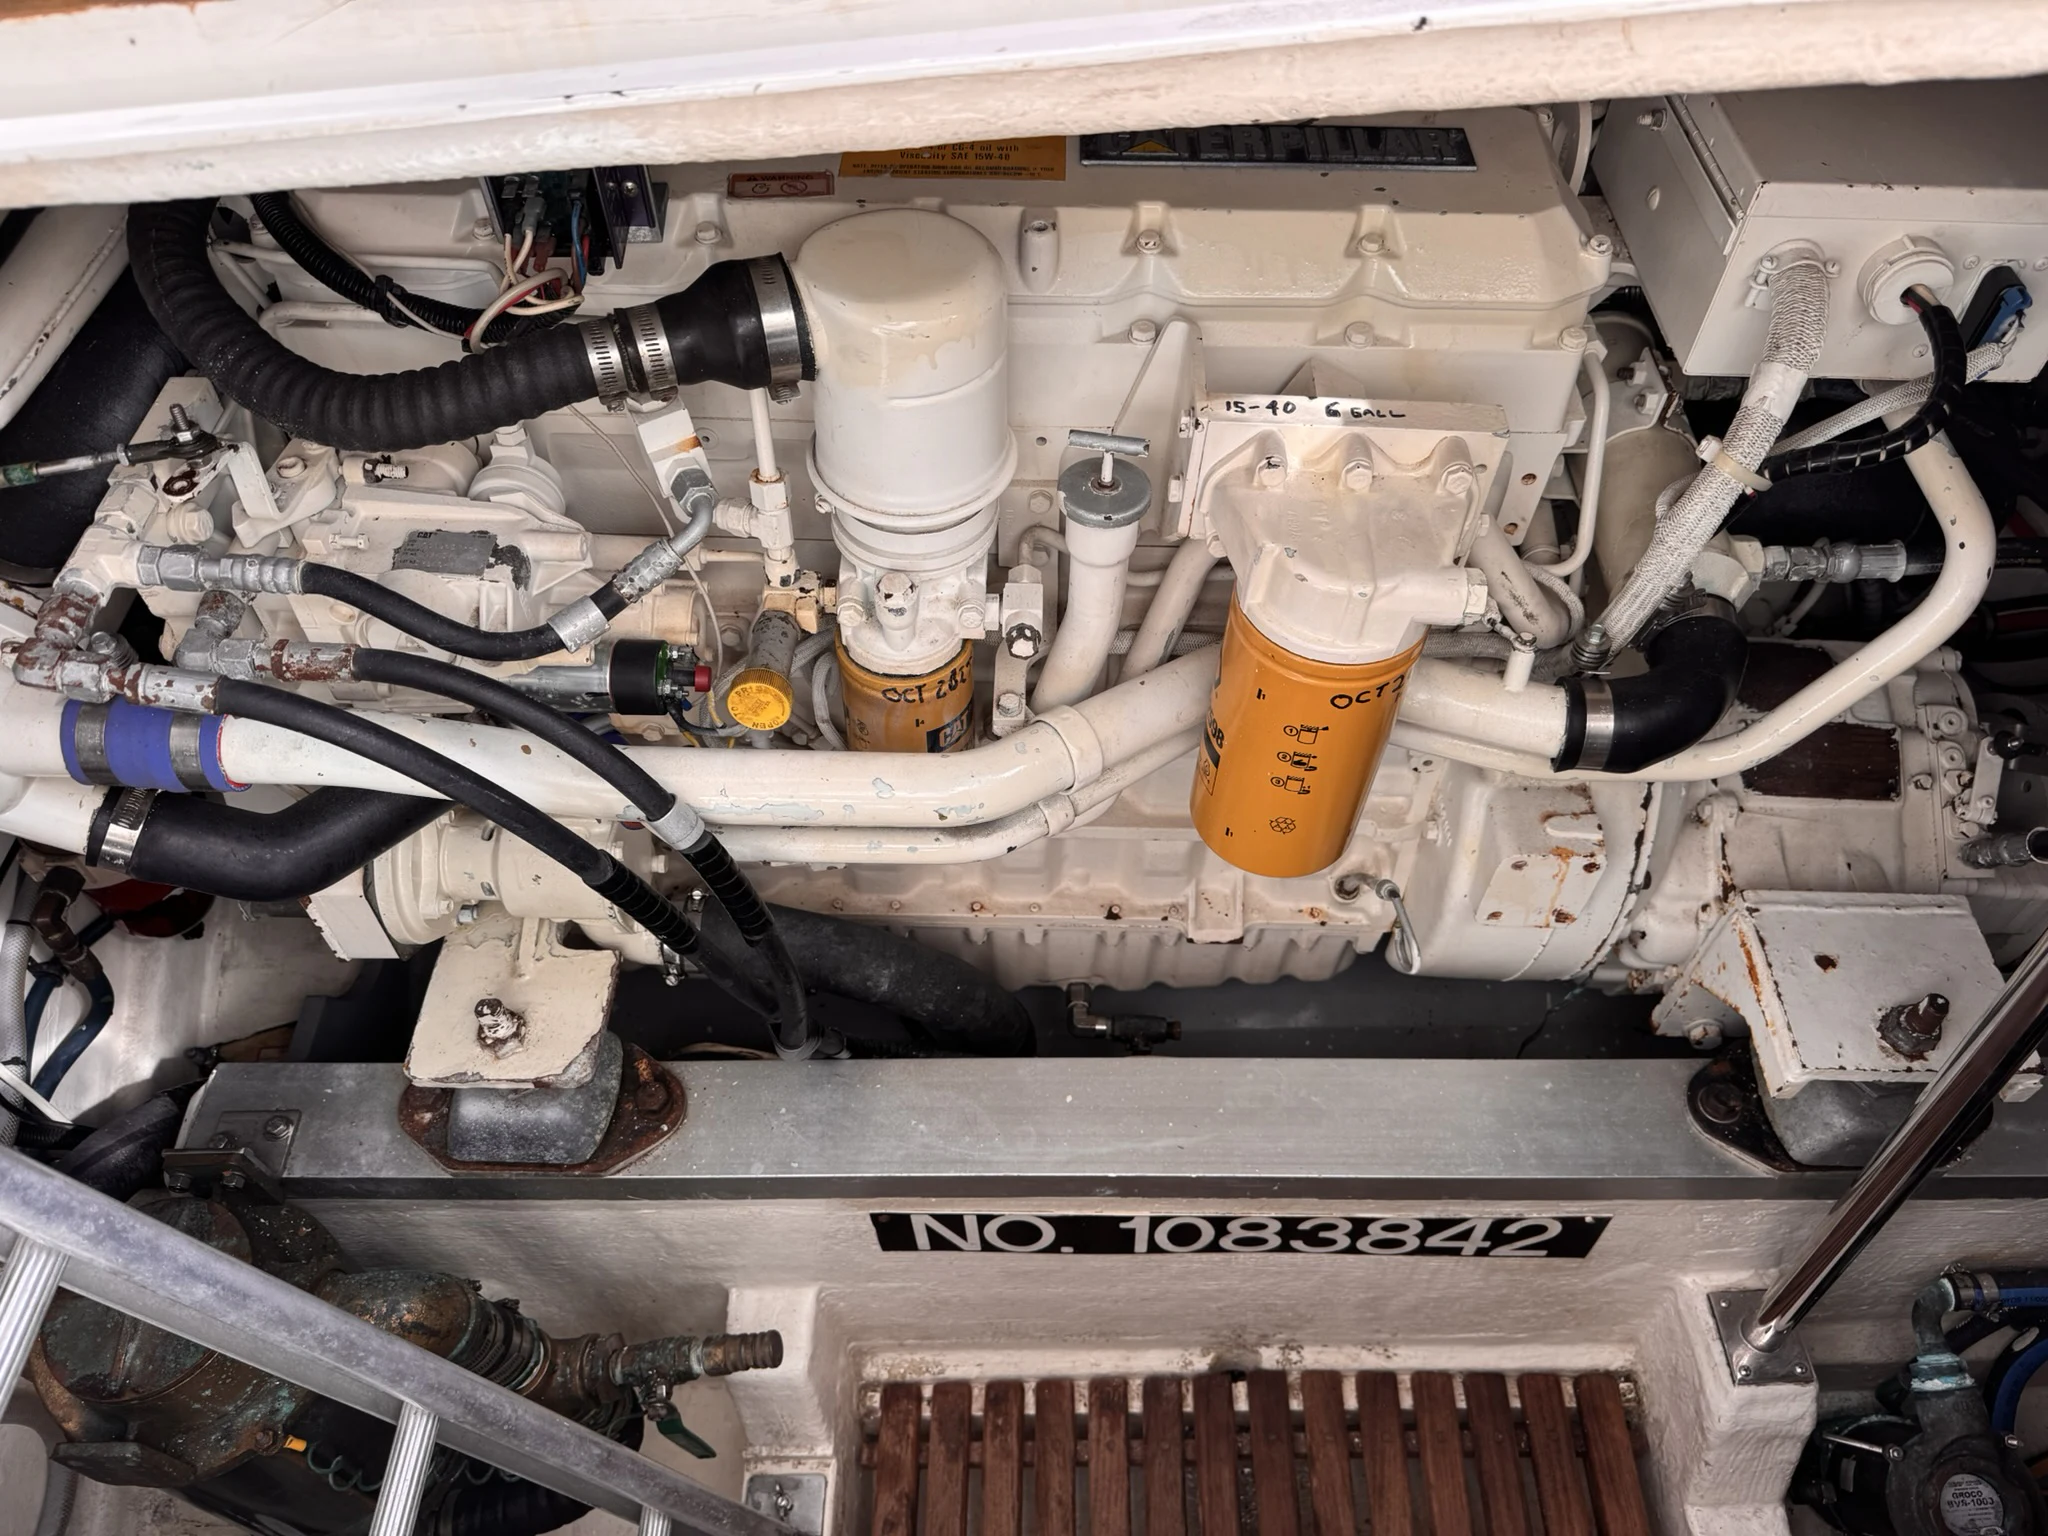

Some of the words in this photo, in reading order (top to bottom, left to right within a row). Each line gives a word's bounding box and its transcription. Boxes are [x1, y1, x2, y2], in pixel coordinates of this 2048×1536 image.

[1225, 400, 1297, 416] 15-40
[881, 684, 926, 703] OCT
[1330, 682, 1390, 709] OCT
[910, 1214, 1074, 1253] NO.
[1119, 1216, 1563, 1257] 1083842
